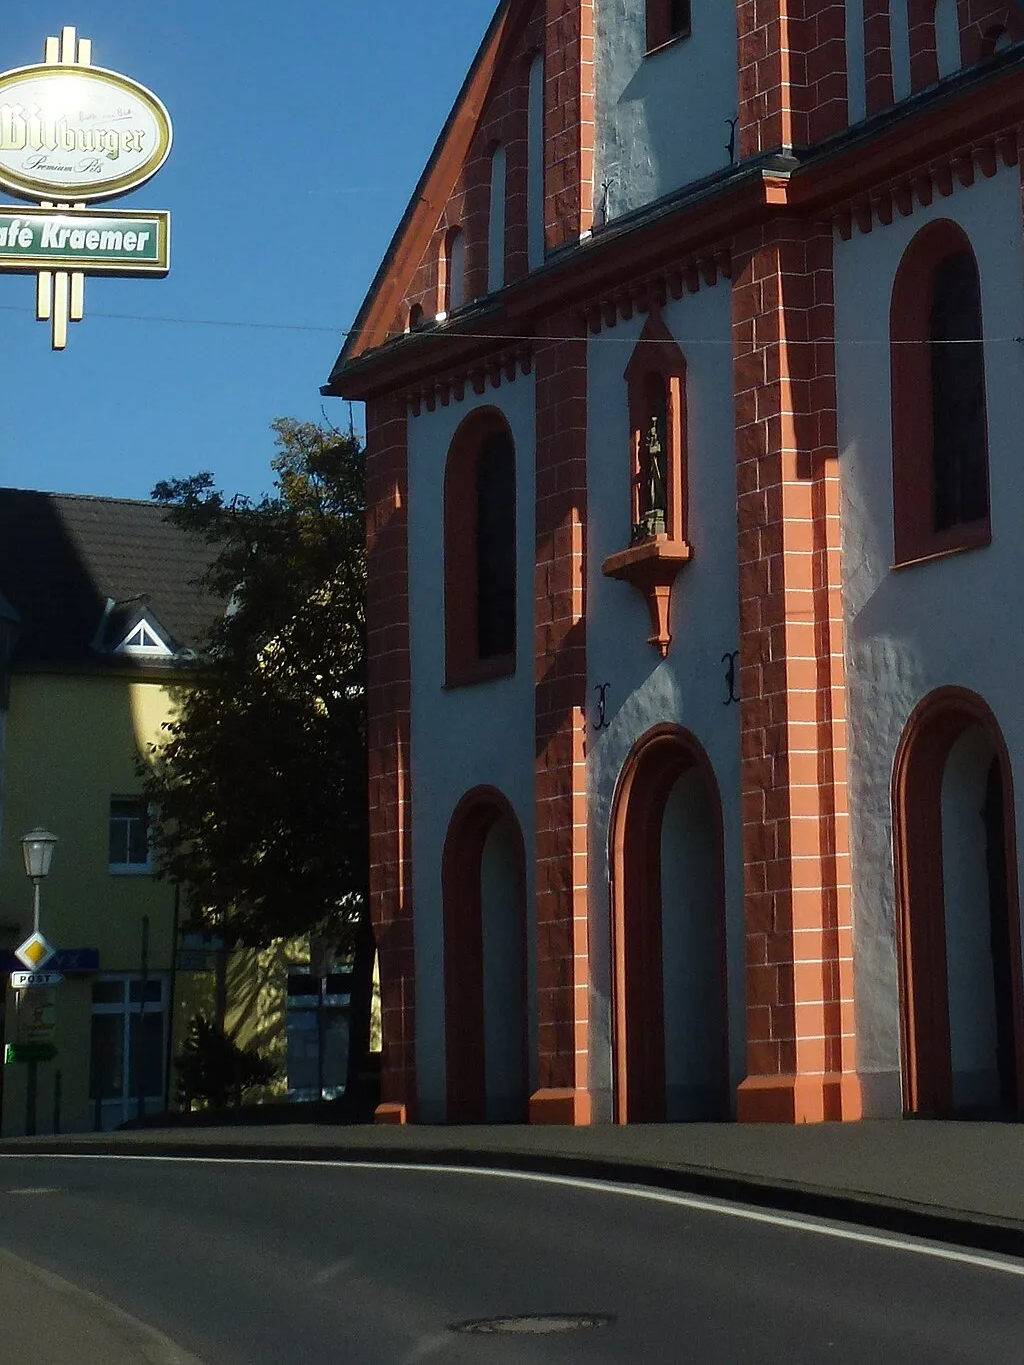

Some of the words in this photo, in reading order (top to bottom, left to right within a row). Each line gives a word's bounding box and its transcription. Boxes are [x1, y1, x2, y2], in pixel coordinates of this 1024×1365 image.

[22, 154, 73, 172] Premium
[74, 157, 104, 174] Pils
[0, 218, 34, 248] afé
[40, 221, 150, 252] Kraemer
[20, 975, 51, 984] POST
